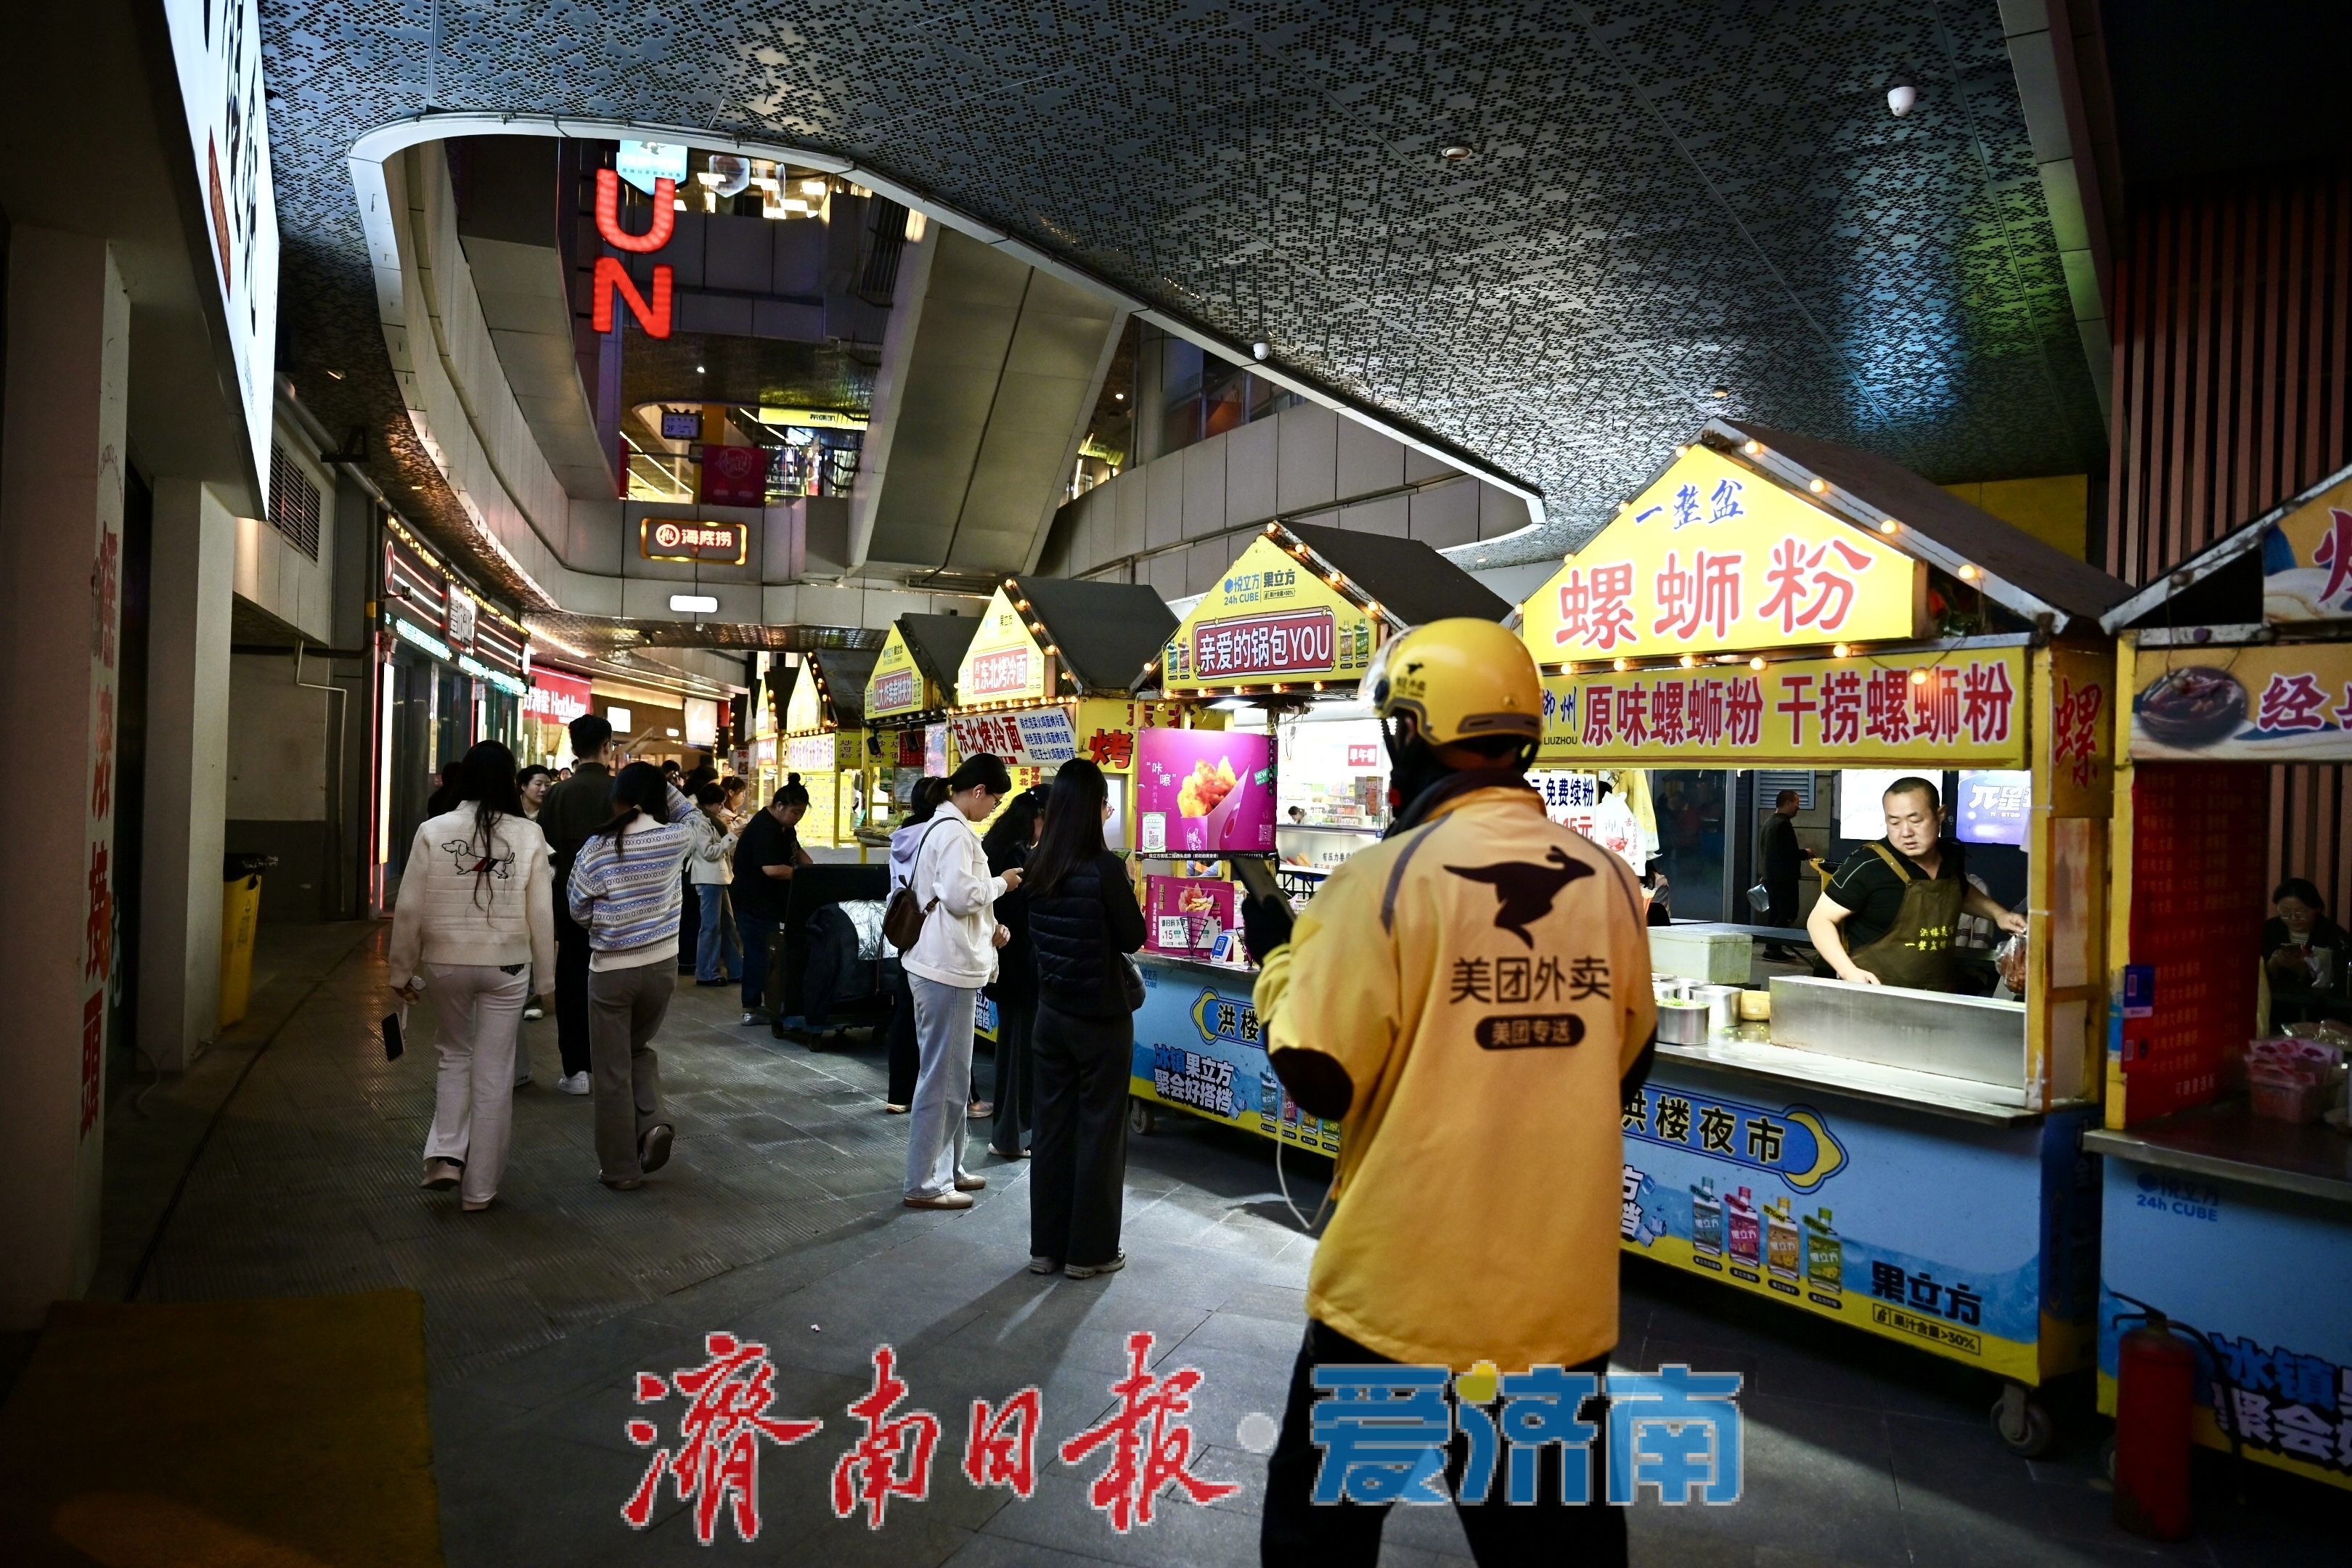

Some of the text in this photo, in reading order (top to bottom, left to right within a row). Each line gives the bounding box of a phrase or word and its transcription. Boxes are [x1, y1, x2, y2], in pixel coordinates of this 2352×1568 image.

[1635, 477, 1744, 530] 一整盆
[681, 528, 732, 547] 海底捞
[1239, 592, 1259, 603] CUBE
[1263, 568, 1296, 588] 果立方
[1555, 536, 1872, 651] 螺蛳粉
[1199, 624, 1330, 673] 亲爱的锅包YOU
[1581, 675, 1764, 747] 原味螺蛳粉
[1777, 660, 2014, 746] 干捞螺蛳粉
[952, 716, 1025, 755] 东北烤冷面
[1089, 727, 1134, 769] 烤
[1543, 735, 1578, 746] LIUZHOU
[1254, 769, 1267, 781] NEW
[1545, 777, 1594, 807] 免费续粉
[1449, 955, 1612, 1005] 美团外卖
[1492, 1018, 1571, 1045] 美团专送
[1153, 1043, 1234, 1087] 冰镇果立方
[1153, 1069, 1234, 1112] 聚会好搭档
[2136, 1193, 2218, 1222] 24h CUBE
[1871, 1259, 1982, 1326] 果立方
